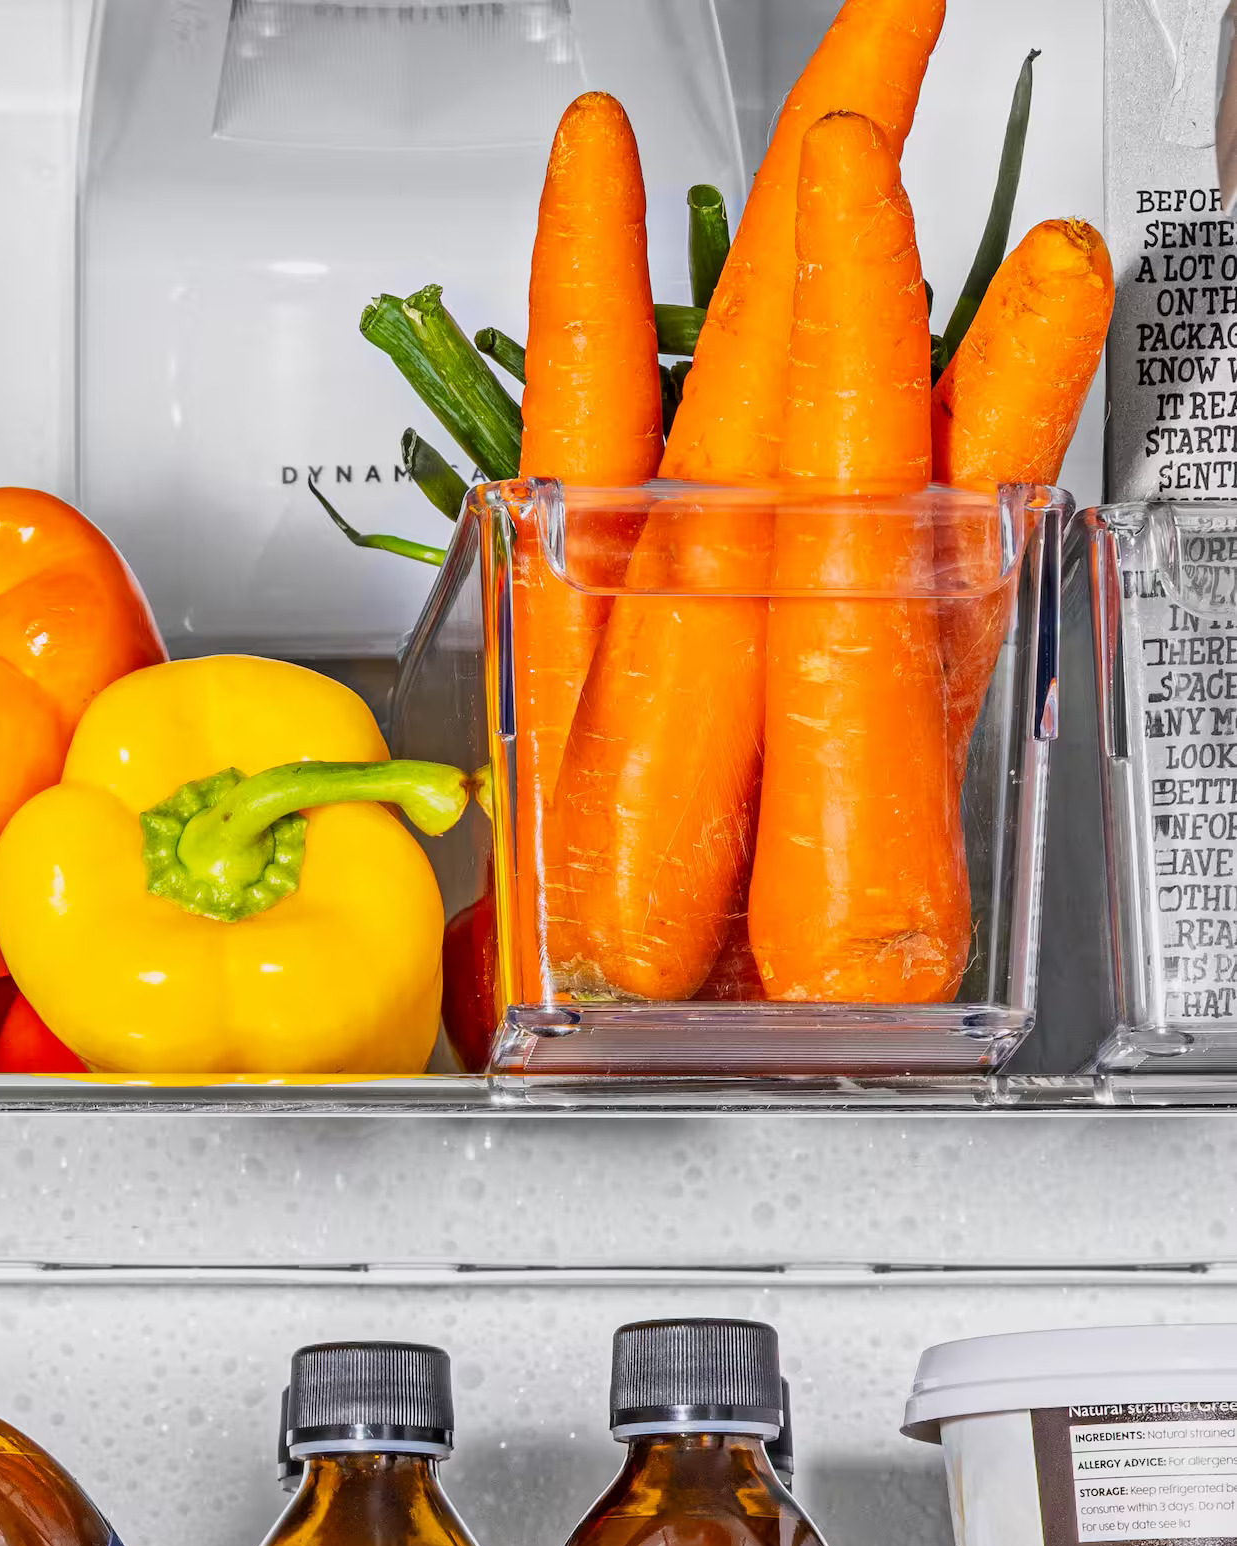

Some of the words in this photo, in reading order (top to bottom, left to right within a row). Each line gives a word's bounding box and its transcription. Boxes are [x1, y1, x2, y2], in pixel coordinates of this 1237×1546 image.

[1135, 256, 1157, 283] A
[1163, 254, 1215, 281] LOT
[1157, 287, 1198, 316] ON
[1136, 356, 1220, 386] KNOW
[1156, 393, 1184, 421] IT
[1145, 425, 1237, 457] START
[1159, 460, 1237, 492] SENT
[1075, 1430, 1146, 1443] INGREDIENTS:
[1147, 1429, 1188, 1440] Natural
[1190, 1427, 1236, 1438] strained
[1078, 1459, 1121, 1470] ALLERGY
[1123, 1457, 1167, 1468] ADVICE:
[1079, 1486, 1129, 1498] STORAGE:
[1130, 1485, 1156, 1497] Keep
[1159, 1483, 1224, 1497] refrigerated
[1081, 1504, 1125, 1515] consume
[1126, 1502, 1158, 1512] within
[1198, 1501, 1214, 1511] Do
[1216, 1500, 1236, 1510] not
[1082, 1522, 1097, 1532] For
[1098, 1522, 1116, 1532] use
[1117, 1521, 1130, 1534] by
[1131, 1519, 1157, 1530] date
[1158, 1519, 1177, 1529] see
